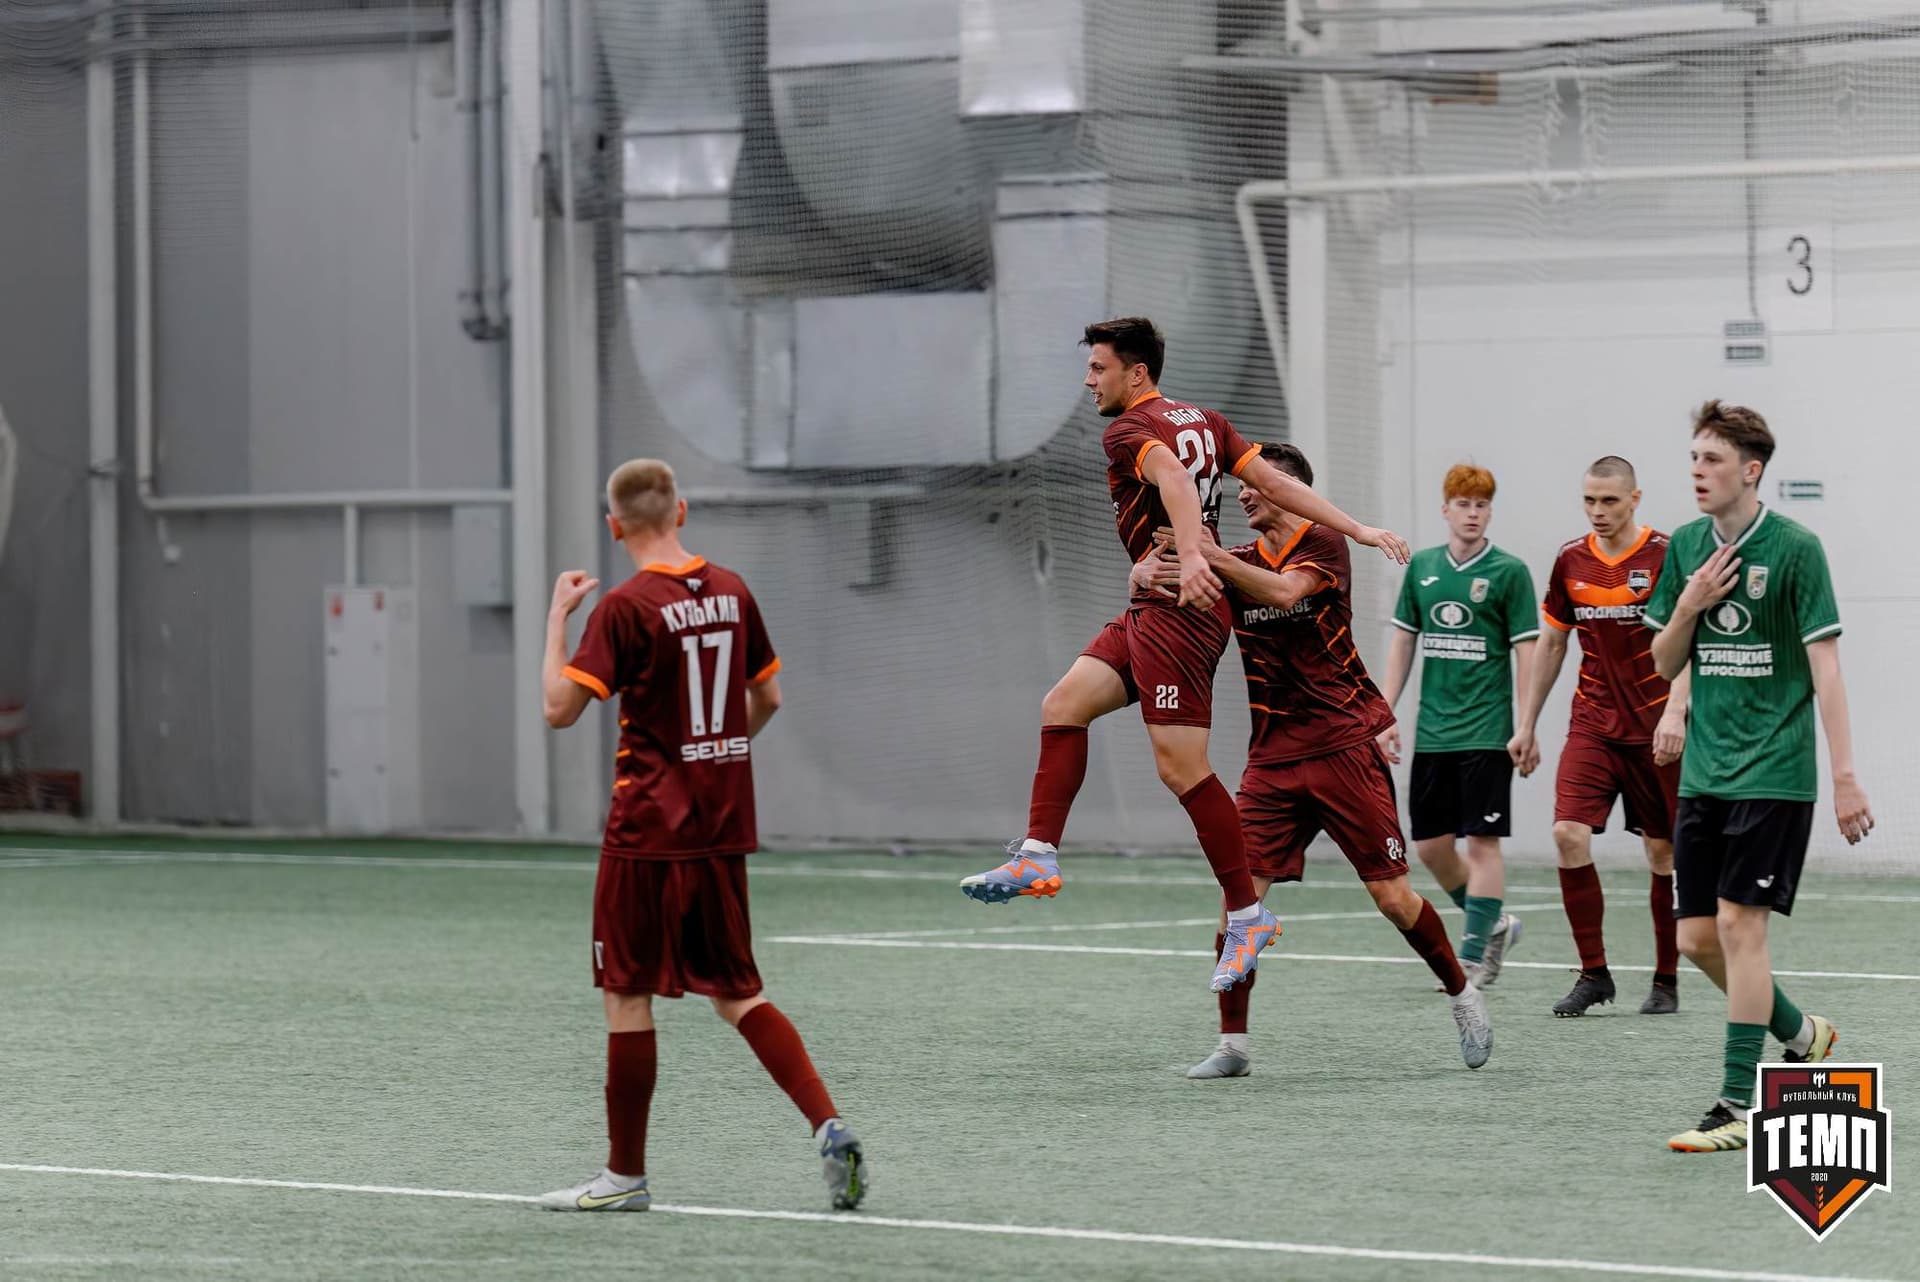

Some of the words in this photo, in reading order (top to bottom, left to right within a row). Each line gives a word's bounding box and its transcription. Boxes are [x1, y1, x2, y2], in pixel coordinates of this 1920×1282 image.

[1787, 236, 1813, 294] 3
[660, 595, 740, 633] КУЗЬКИН
[681, 630, 733, 736] 17
[1156, 684, 1179, 709] 22
[680, 737, 749, 762] SEUS
